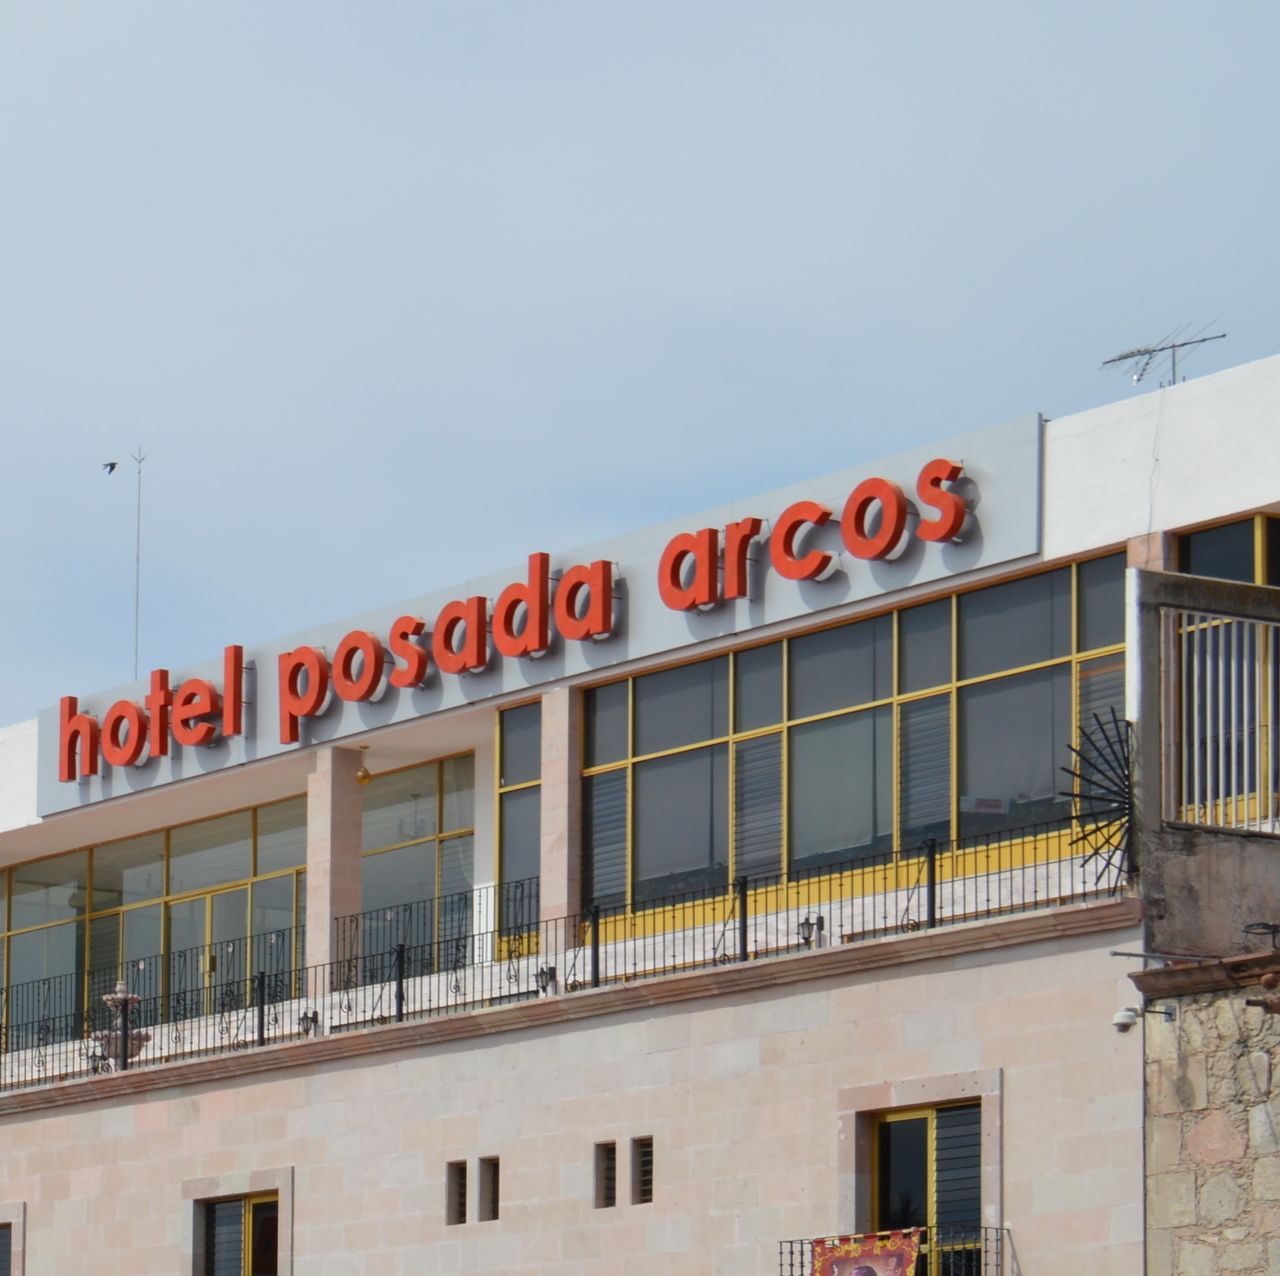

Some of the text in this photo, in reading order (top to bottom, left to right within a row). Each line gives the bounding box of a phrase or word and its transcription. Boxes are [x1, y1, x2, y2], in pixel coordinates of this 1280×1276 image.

[59, 458, 965, 782] hotel posada arcos
